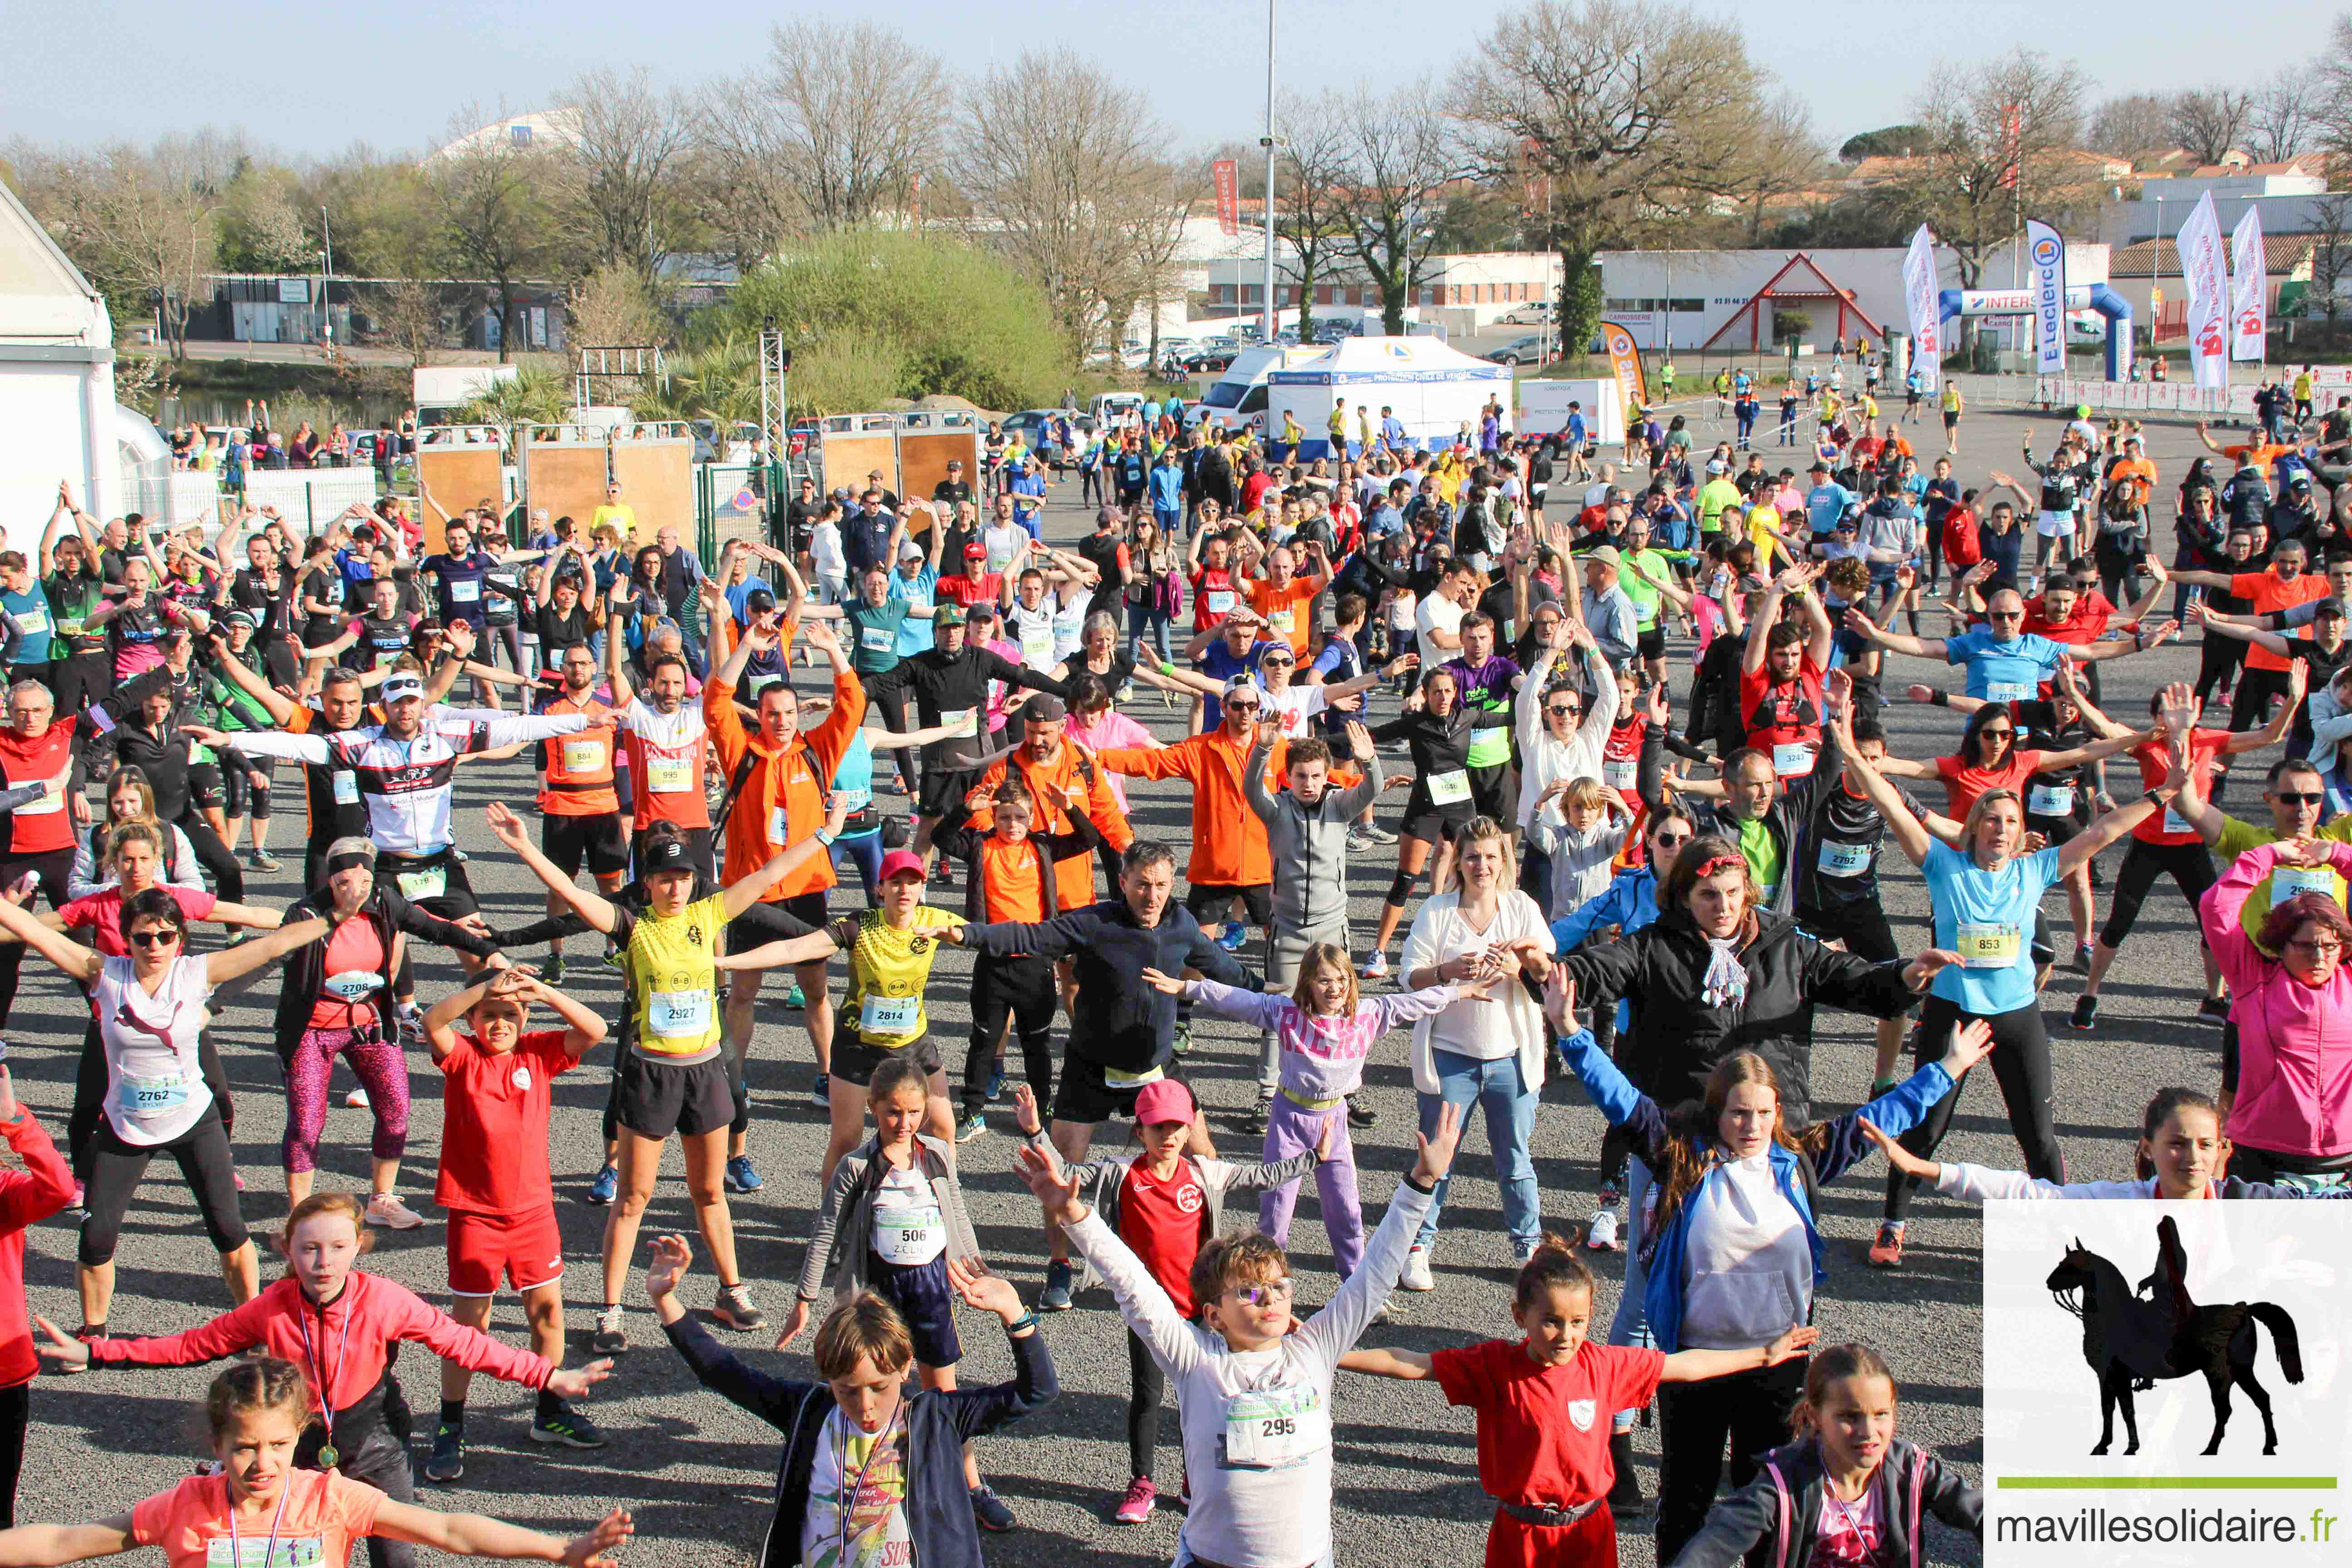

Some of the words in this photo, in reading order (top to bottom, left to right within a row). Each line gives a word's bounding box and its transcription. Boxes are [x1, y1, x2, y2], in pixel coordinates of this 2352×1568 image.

[1986, 294, 2078, 309] INTERSRT
[1373, 373, 1415, 382] PROTECTION
[1416, 372, 1436, 382] CIVILE
[1787, 754, 1804, 763] 3243
[1441, 783, 1458, 792] 1646
[2041, 797, 2061, 805] 3029
[1832, 855, 1855, 865] 2792
[1979, 940, 2000, 950] 853
[342, 983, 368, 993] 2708
[668, 1007, 696, 1019] 2927
[877, 1010, 903, 1020] 2814
[138, 1090, 169, 1101] 2762
[902, 1230, 926, 1242] 506
[1262, 1418, 1296, 1437] 295
